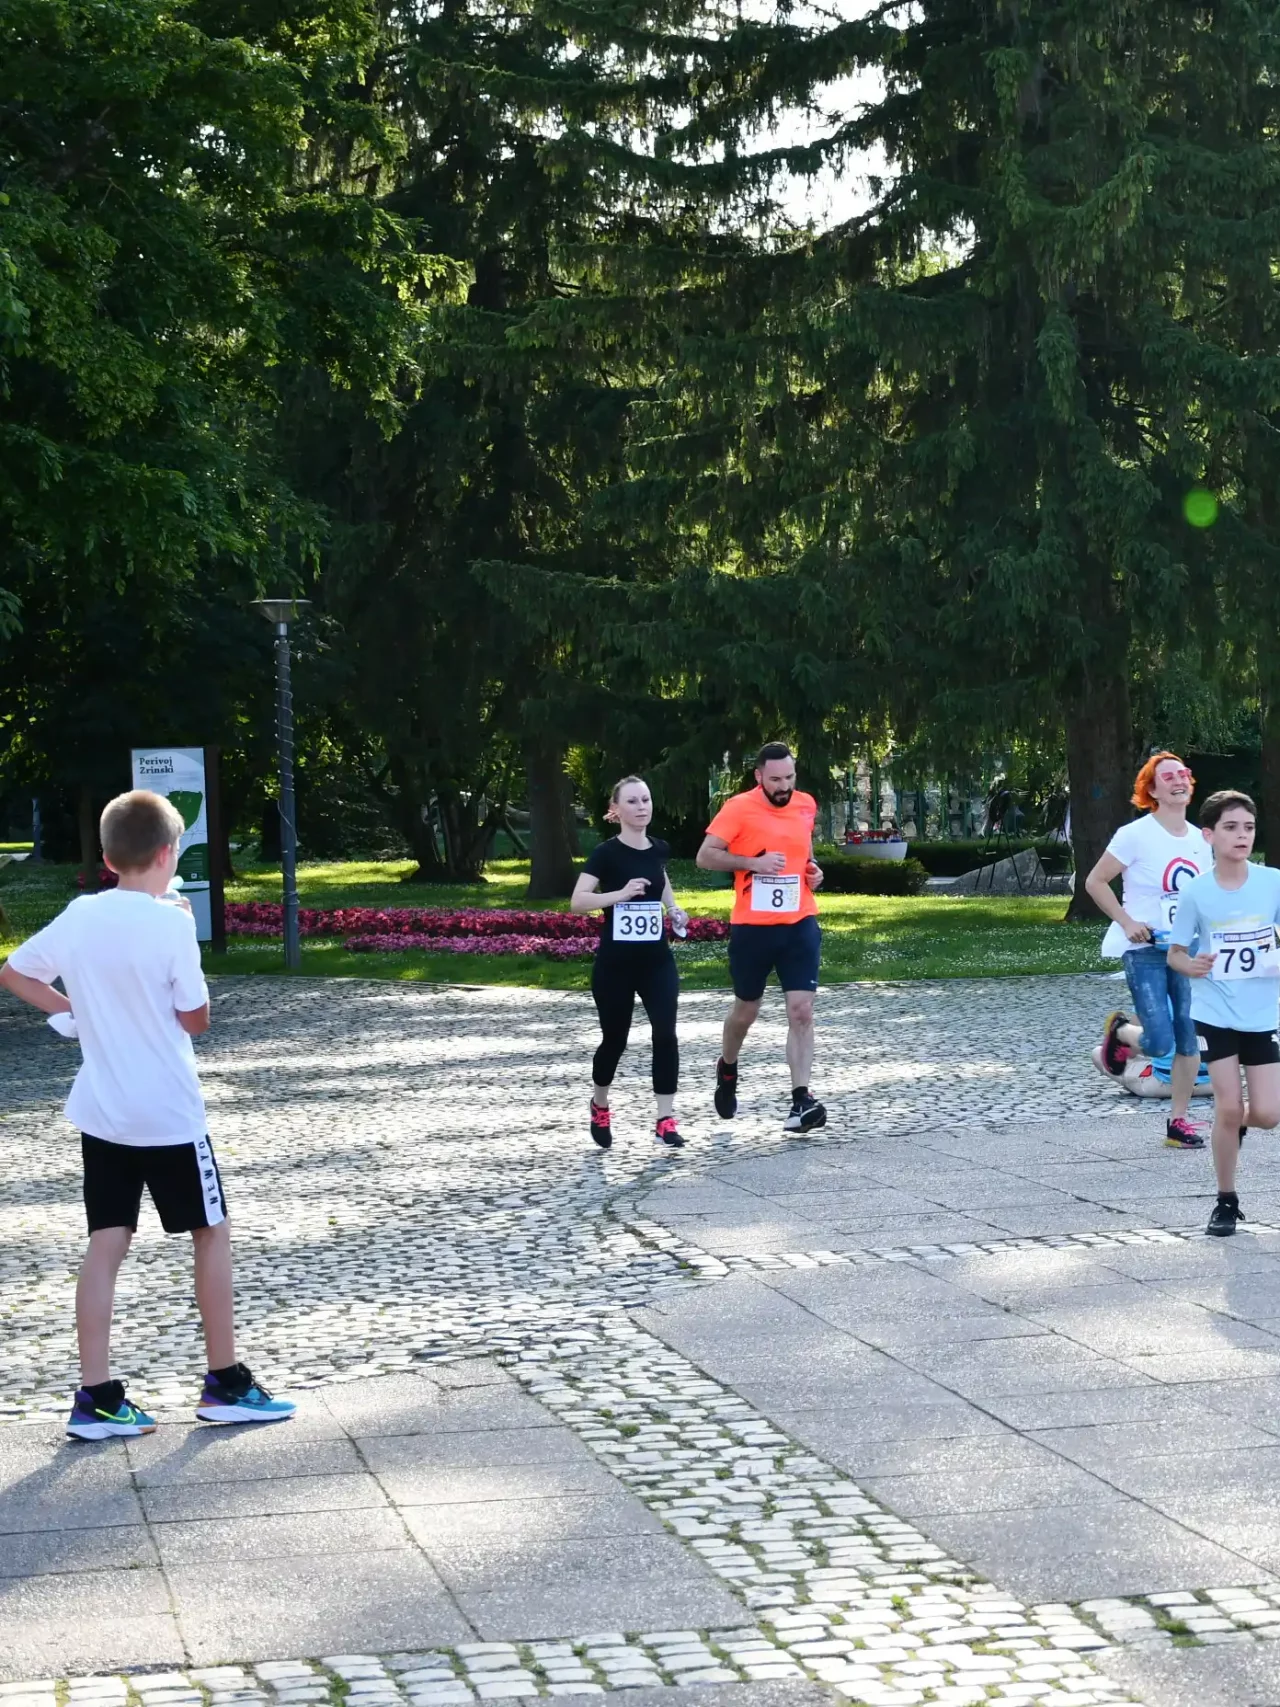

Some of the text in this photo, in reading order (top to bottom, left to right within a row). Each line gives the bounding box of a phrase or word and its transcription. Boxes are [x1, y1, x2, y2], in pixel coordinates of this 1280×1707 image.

[139, 756, 173, 767] Perivoj
[139, 766, 174, 774] Zrinski
[772, 888, 784, 908] 8
[620, 915, 660, 936] 398
